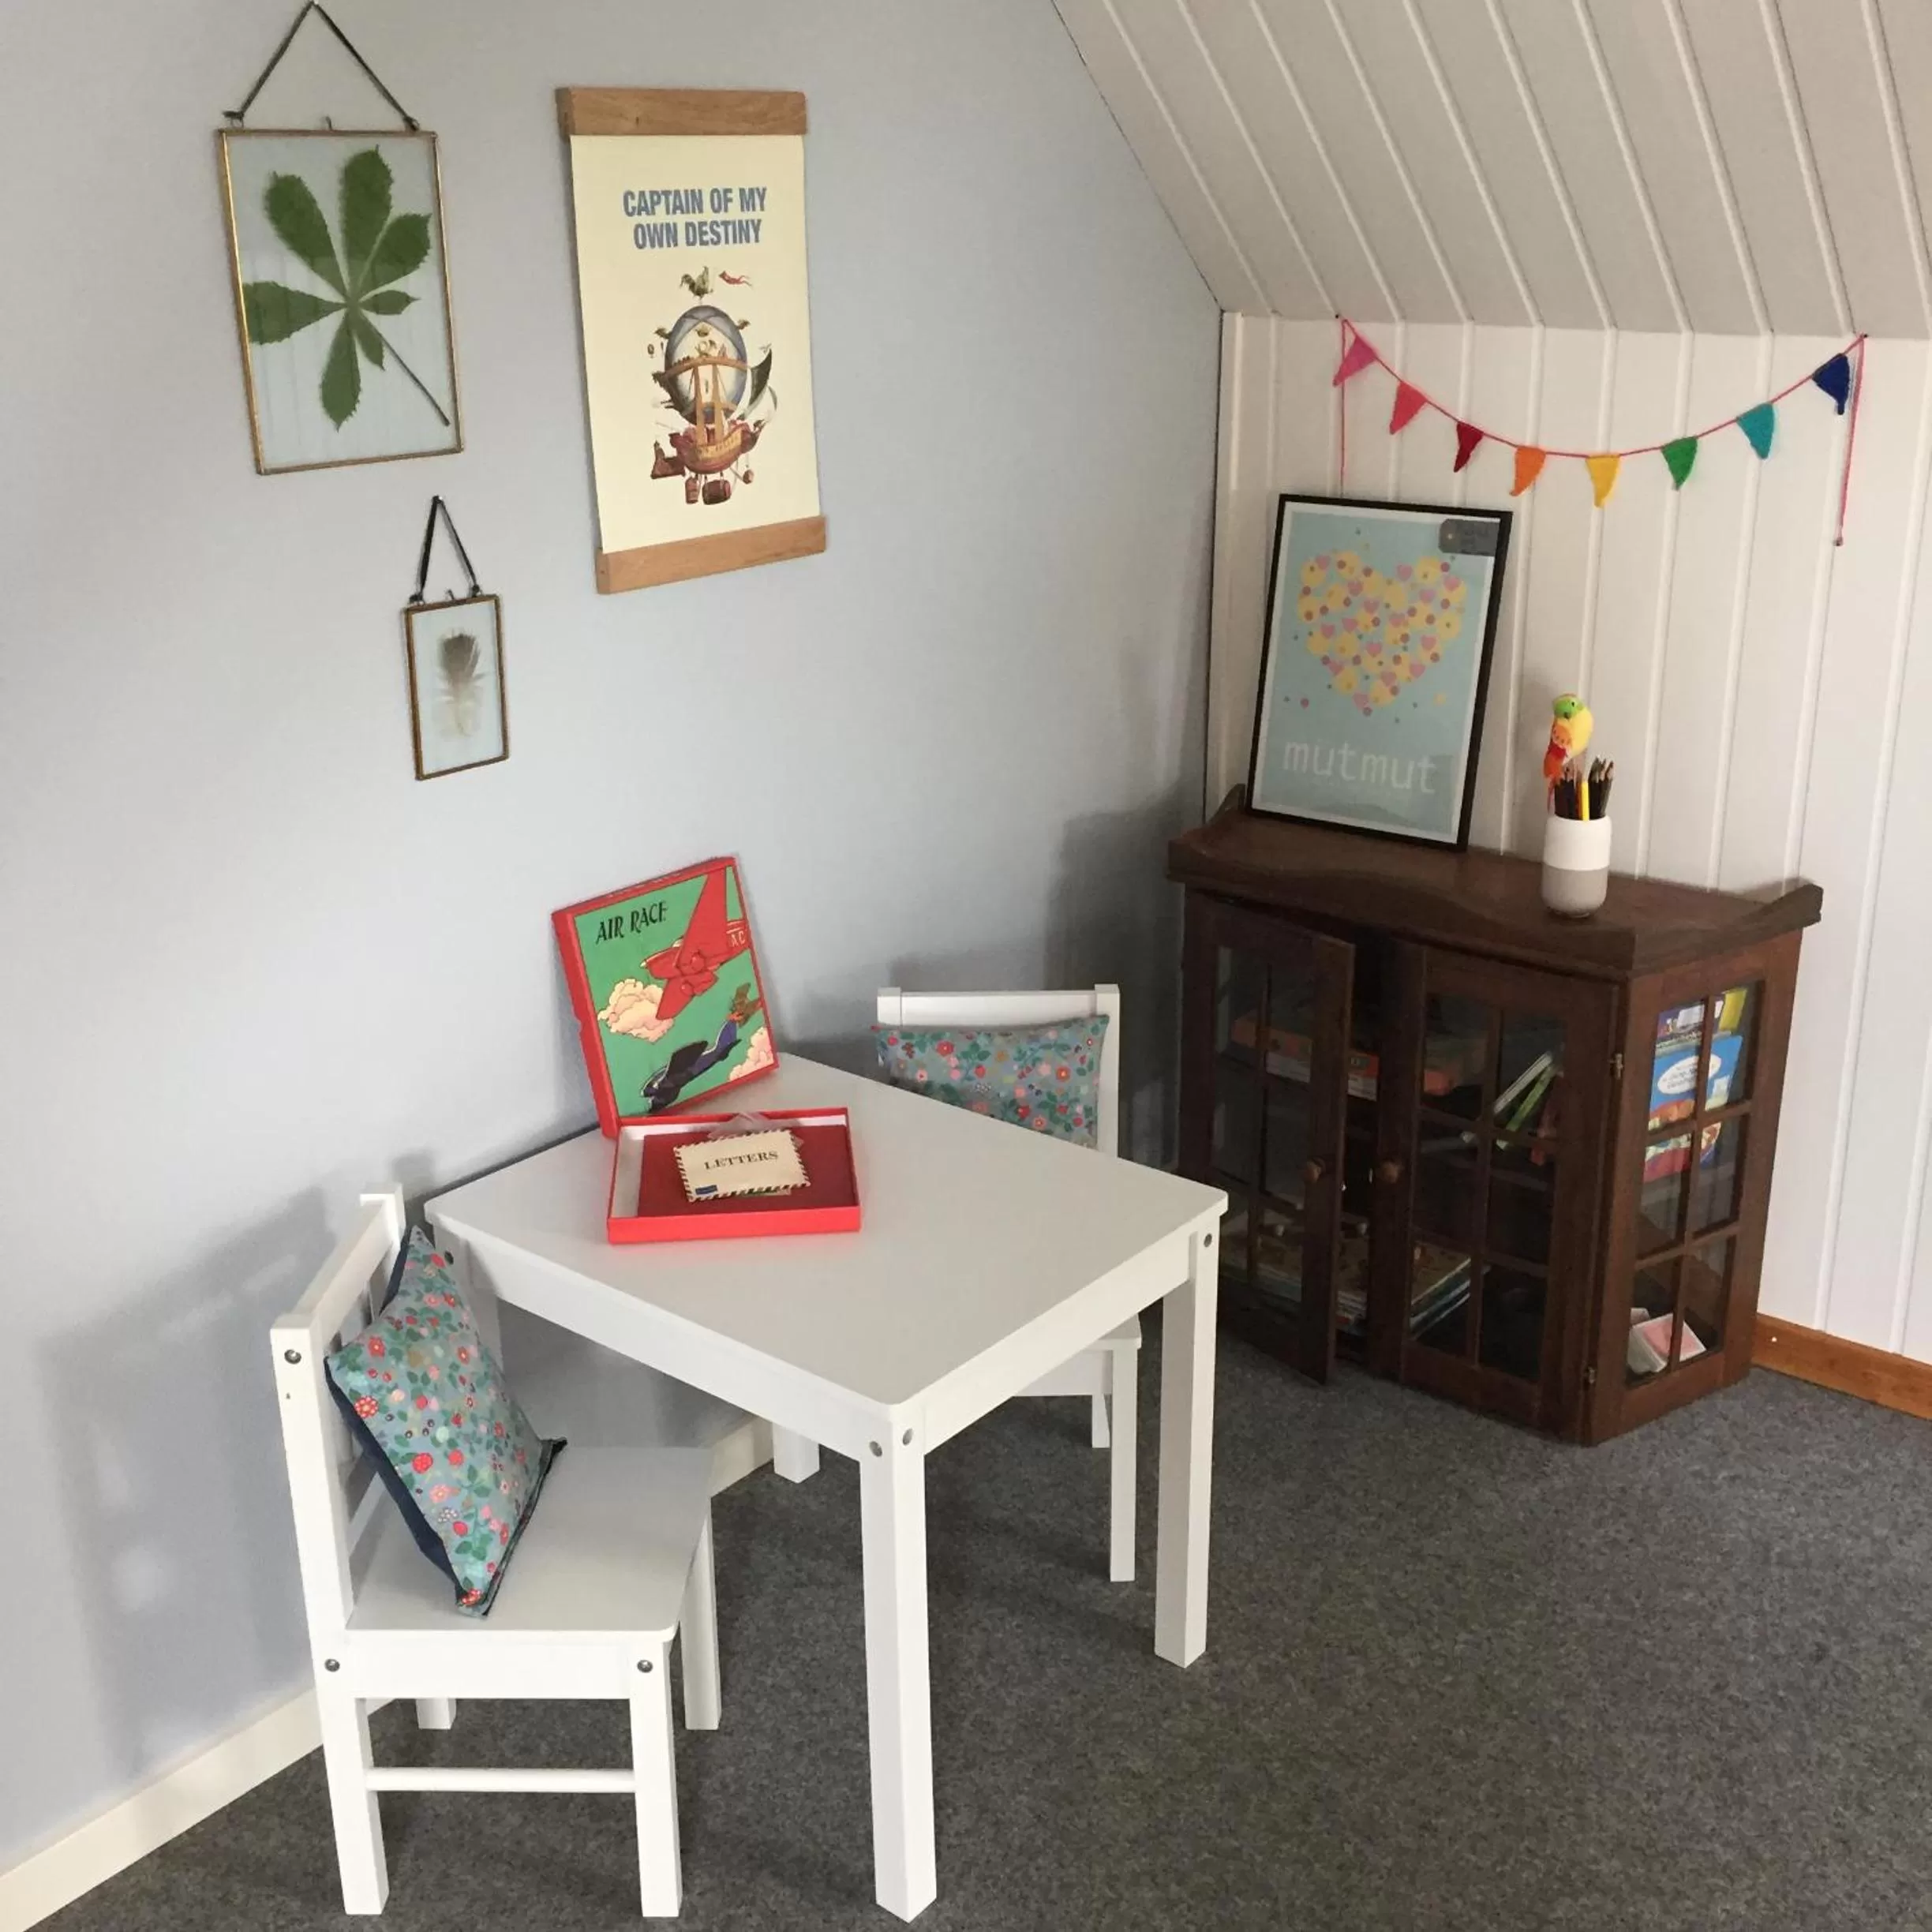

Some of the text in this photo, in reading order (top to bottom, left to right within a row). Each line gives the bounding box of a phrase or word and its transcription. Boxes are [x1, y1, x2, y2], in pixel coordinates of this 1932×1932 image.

[623, 186, 767, 217] CAPTAIN OF MY
[633, 219, 762, 249] OWN DESTINY
[1282, 741, 1437, 794] mutmut
[596, 900, 668, 945] AIR RACE
[704, 1151, 779, 1170] LETTERS
